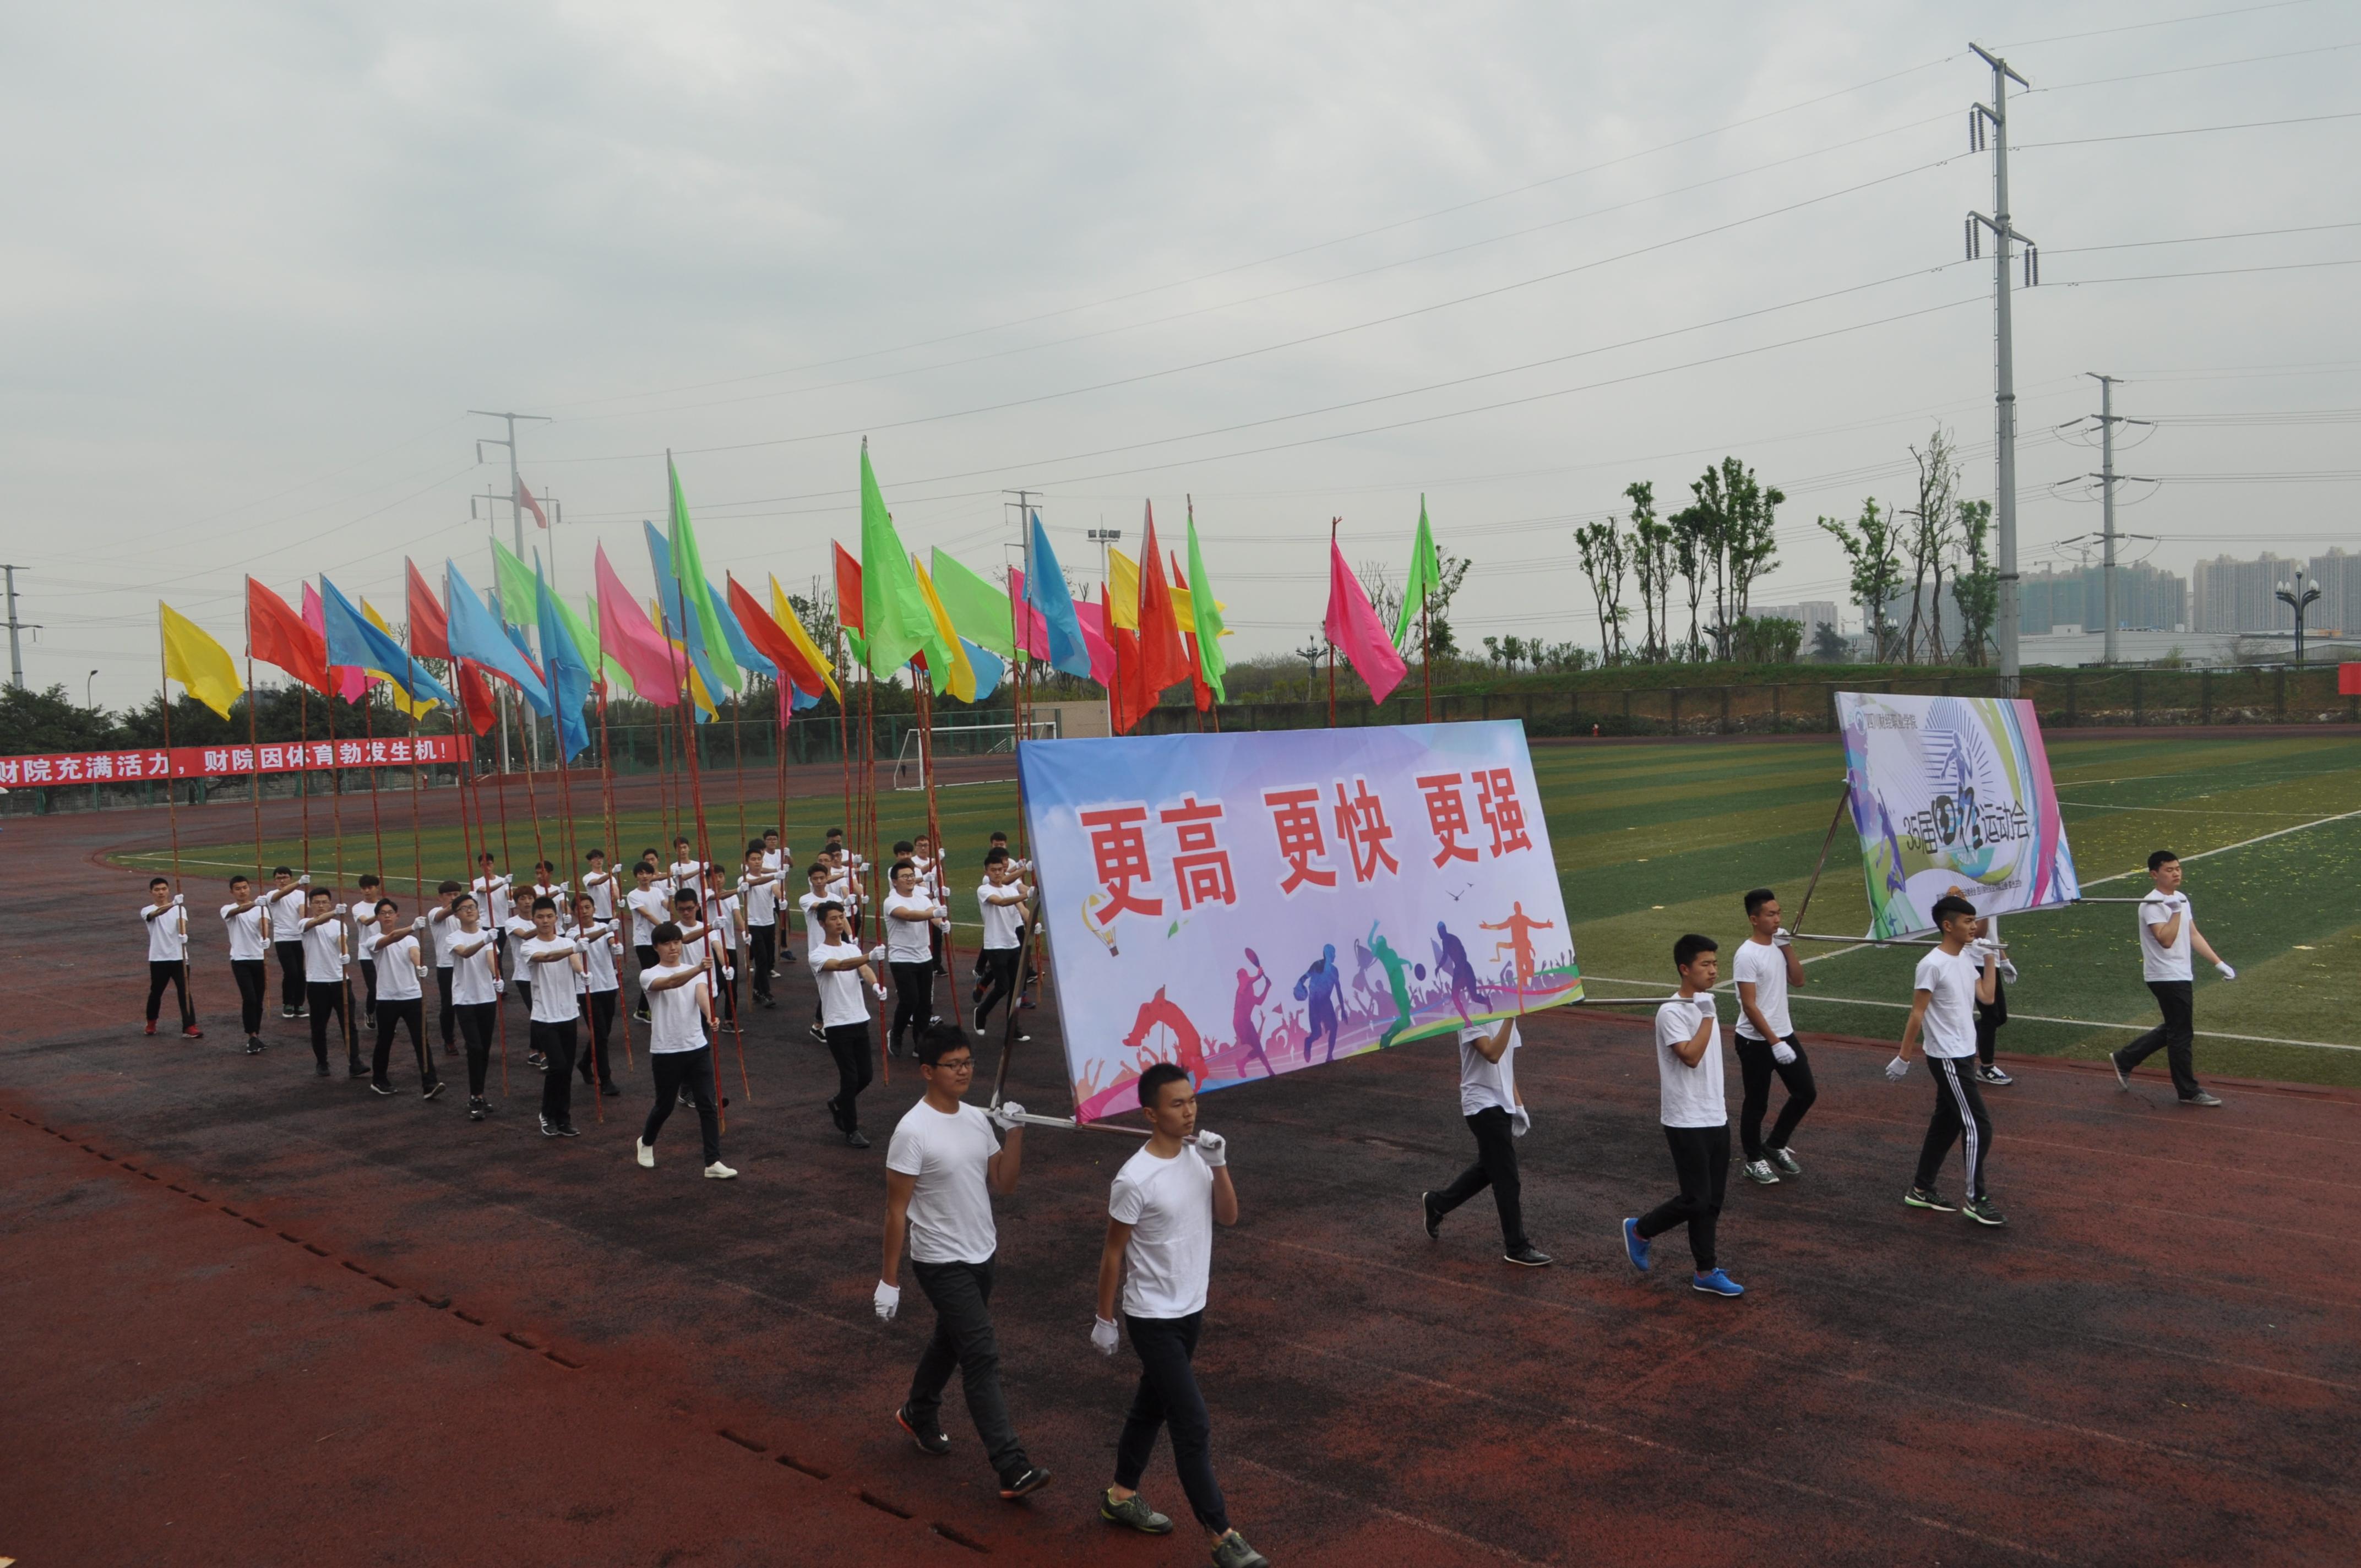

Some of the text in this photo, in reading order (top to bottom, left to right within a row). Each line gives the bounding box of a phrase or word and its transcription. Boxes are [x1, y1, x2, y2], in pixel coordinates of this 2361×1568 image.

[1080, 768, 1532, 924] 更高 更快 更强
